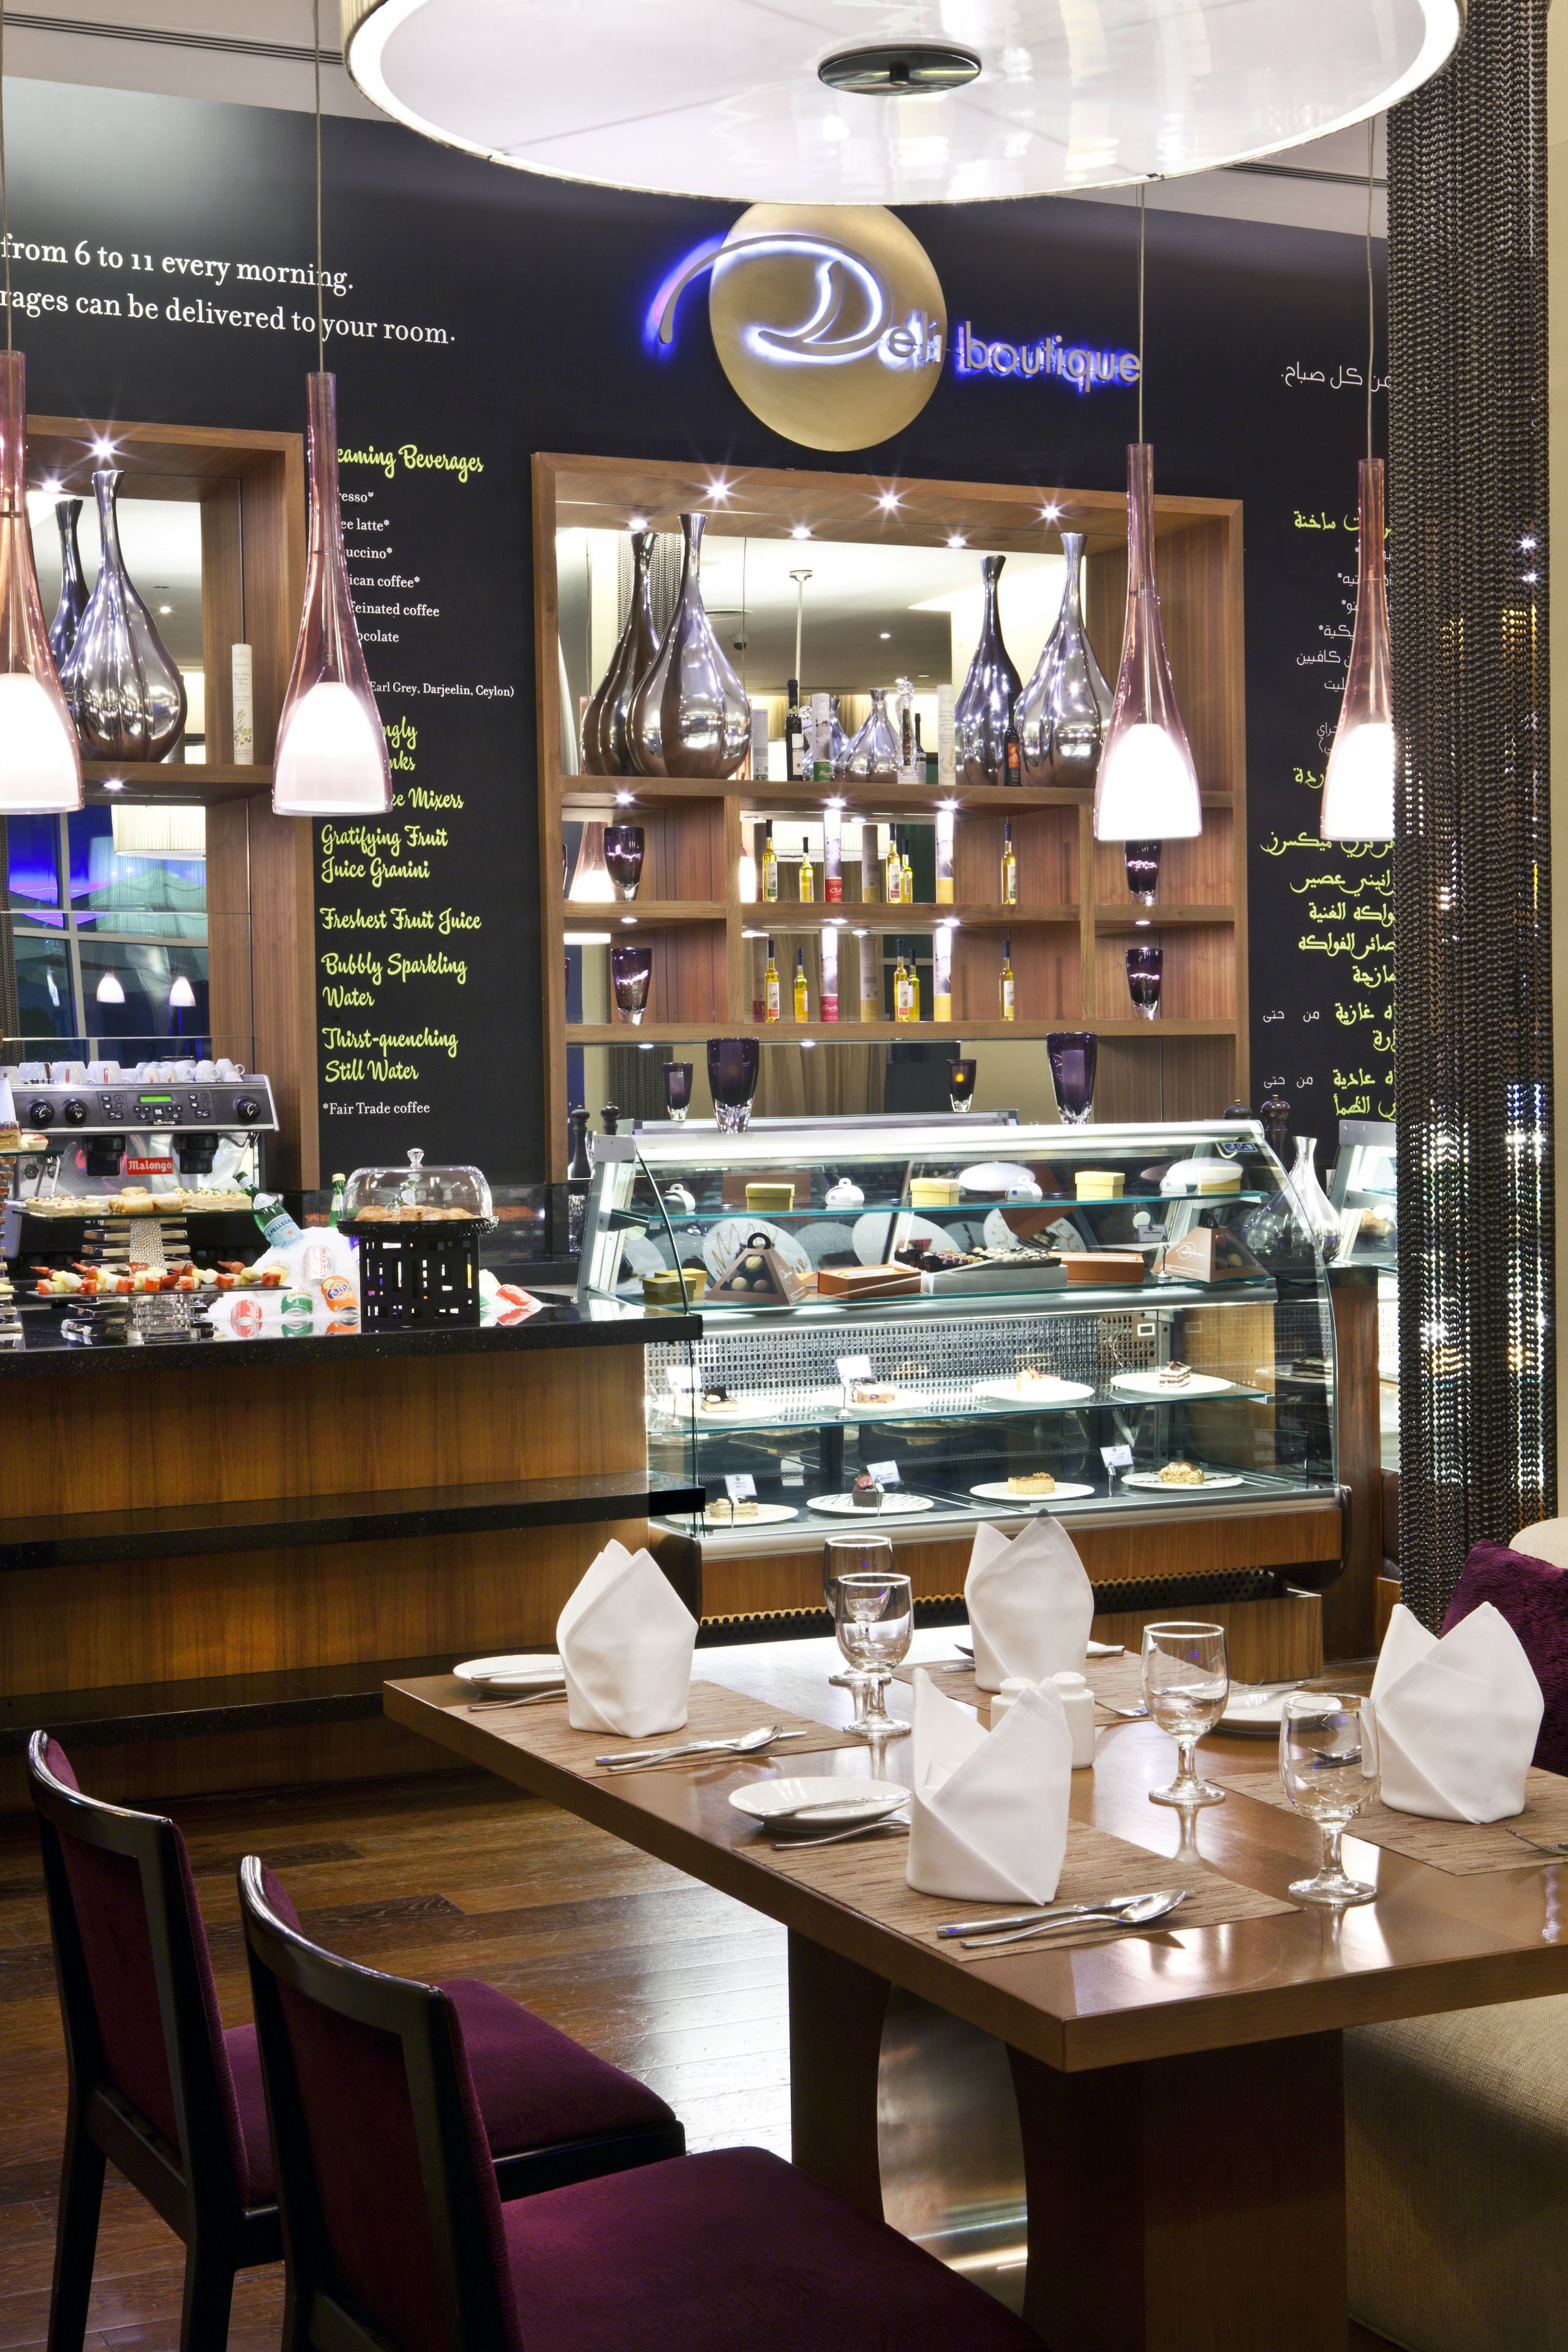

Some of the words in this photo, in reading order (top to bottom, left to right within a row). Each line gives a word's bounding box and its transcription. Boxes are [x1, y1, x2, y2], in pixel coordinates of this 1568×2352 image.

[1, 233, 69, 263] from
[75, 239, 91, 265] 6
[97, 246, 124, 269] to
[162, 257, 231, 286] every
[236, 265, 353, 297] morning.
[75, 295, 121, 317] can
[127, 293, 159, 320] be
[165, 297, 285, 331] delivered
[291, 311, 316, 333] to
[322, 317, 378, 342] your
[383, 322, 456, 345] room.
[658, 233, 943, 363] Deli
[963, 321, 1142, 393] boutique
[1281, 361, 1325, 387] صباح.
[1330, 365, 1363, 390] كل
[398, 444, 484, 483] Beverages
[403, 603, 440, 617] coffee
[1296, 649, 1341, 666] كافيين
[393, 682, 420, 696] Grey,
[423, 682, 473, 698] Darjeelin,
[475, 685, 514, 699] Ceylon)
[408, 787, 464, 811] Mixers
[321, 824, 401, 858] Gratifying
[404, 825, 448, 847] Fruit
[320, 857, 366, 884] Juice
[369, 855, 430, 888] Granini
[1289, 873, 1346, 894] عصير
[319, 907, 387, 930] Freshest
[390, 908, 434, 930] Fruit
[437, 908, 481, 935] Juice
[321, 952, 383, 986] Bubbly
[386, 952, 468, 984] Sparkling
[322, 986, 375, 1008] Water
[1263, 1010, 1285, 1023] حتى
[1303, 1011, 1320, 1023] من
[322, 1027, 458, 1058] Thirst-quenching
[325, 1058, 365, 1082] Still
[367, 1059, 419, 1082] Water
[1296, 1076, 1313, 1088] من
[1264, 1076, 1286, 1089] حتى
[355, 1101, 391, 1115] Trade
[393, 1101, 430, 1114] coffee
[128, 1159, 173, 1172] Malongo
